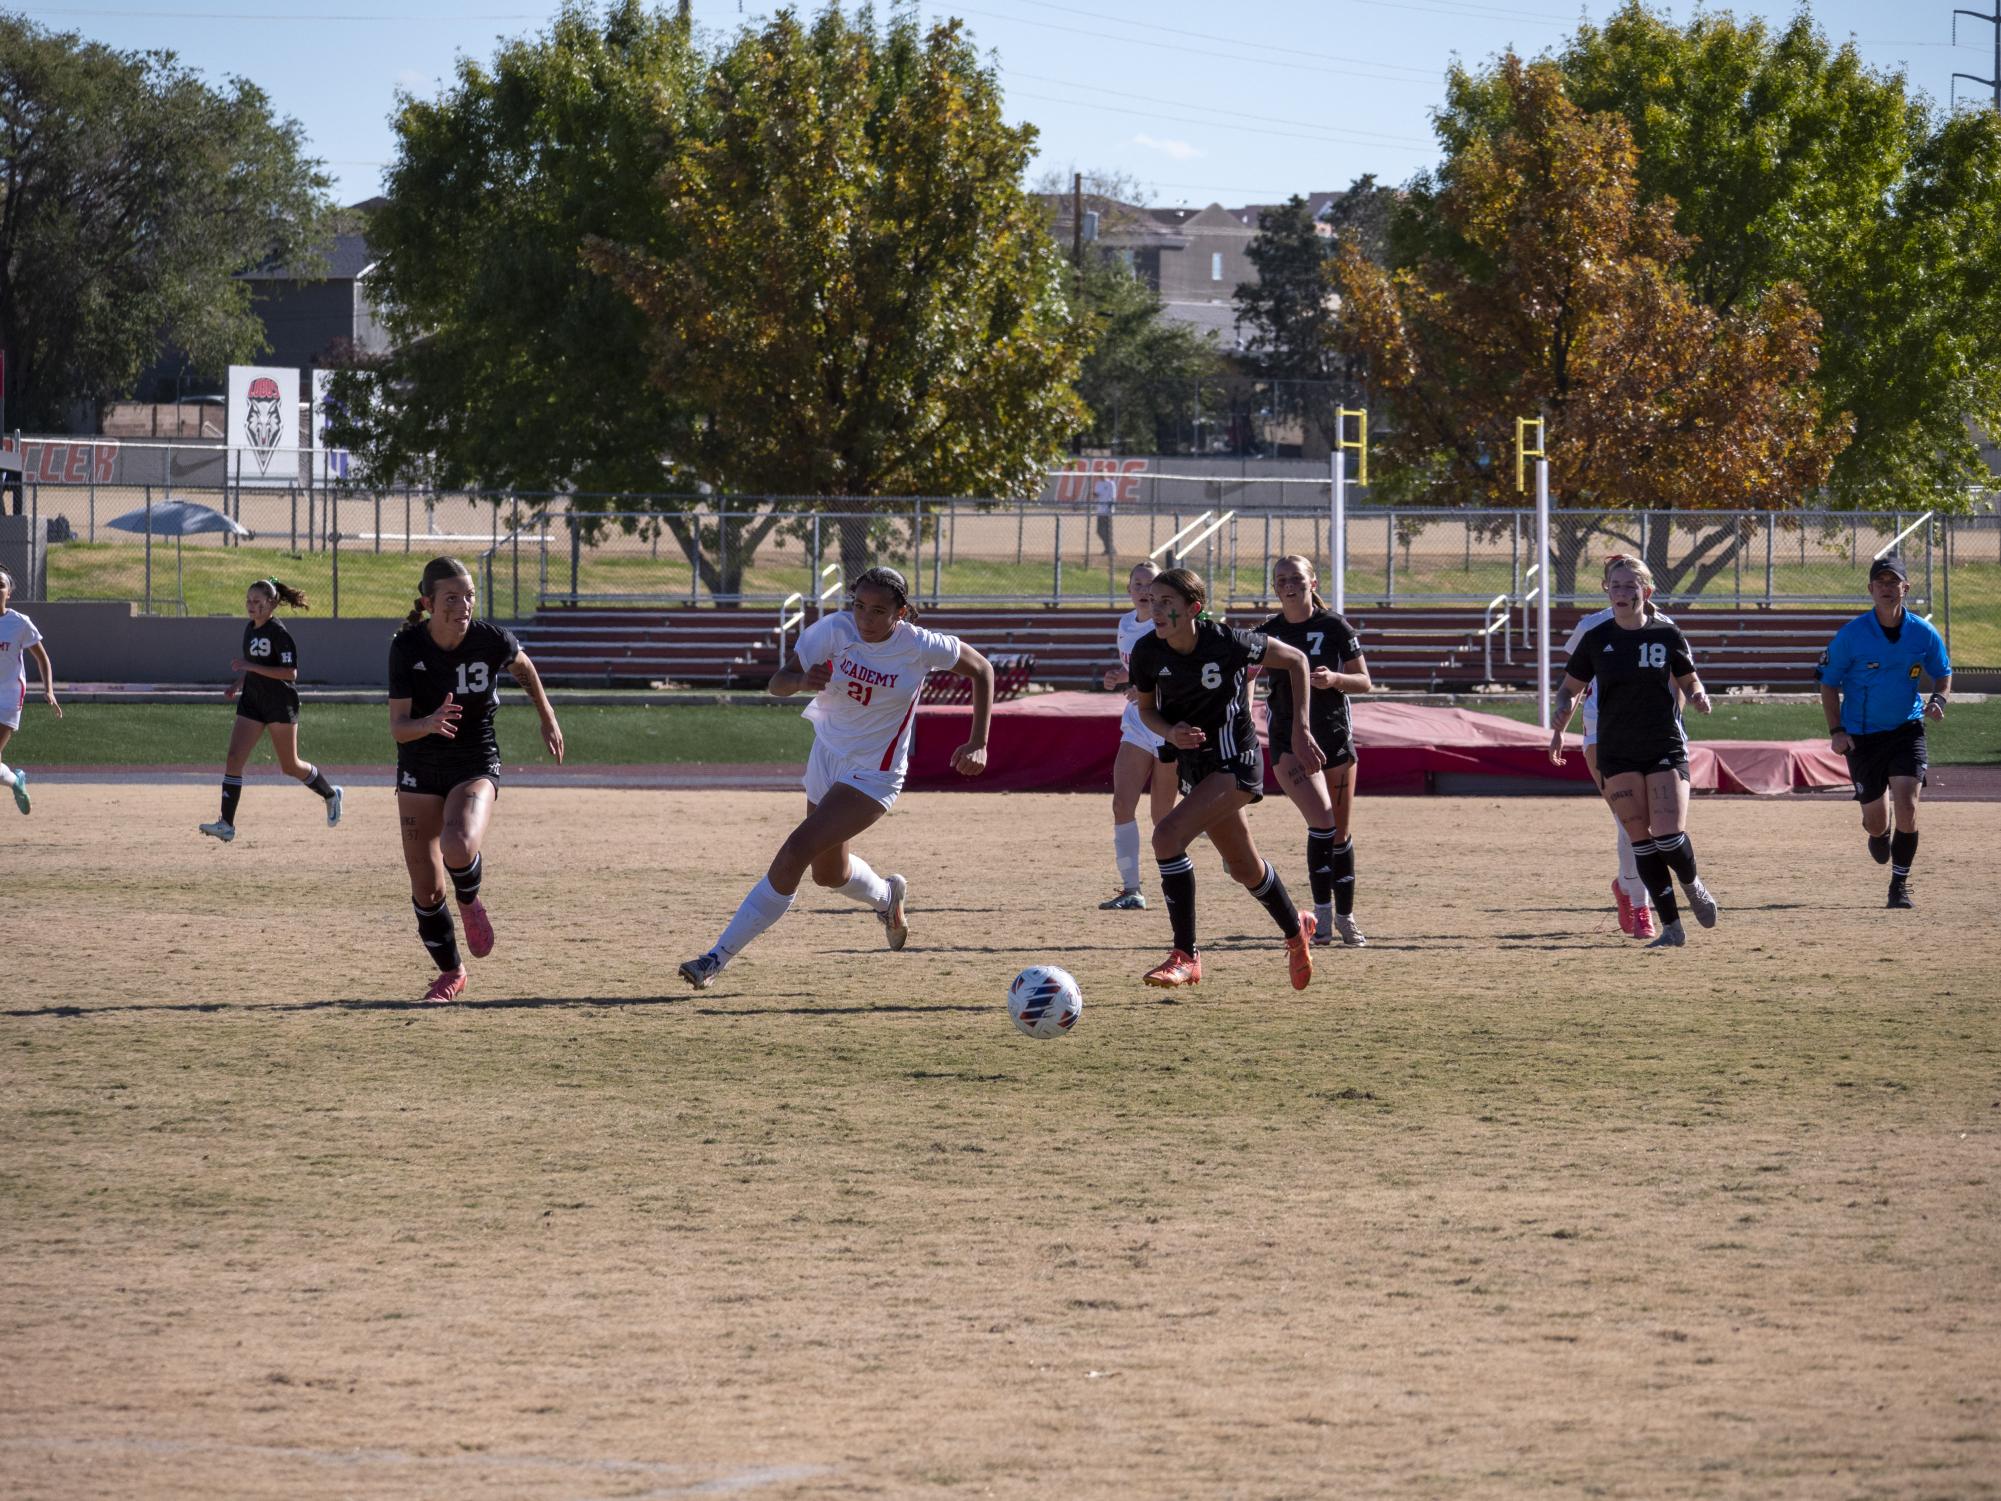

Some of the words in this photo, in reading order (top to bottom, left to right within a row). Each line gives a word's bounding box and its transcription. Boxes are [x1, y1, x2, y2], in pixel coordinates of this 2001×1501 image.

[246, 377, 280, 399] LOBOS
[249, 637, 272, 657] 29
[1306, 631, 1325, 655] 7
[1638, 642, 1666, 668] 18
[281, 652, 293, 664] H
[456, 662, 489, 694] 13
[1201, 662, 1223, 690] 6
[847, 681, 873, 707] 21
